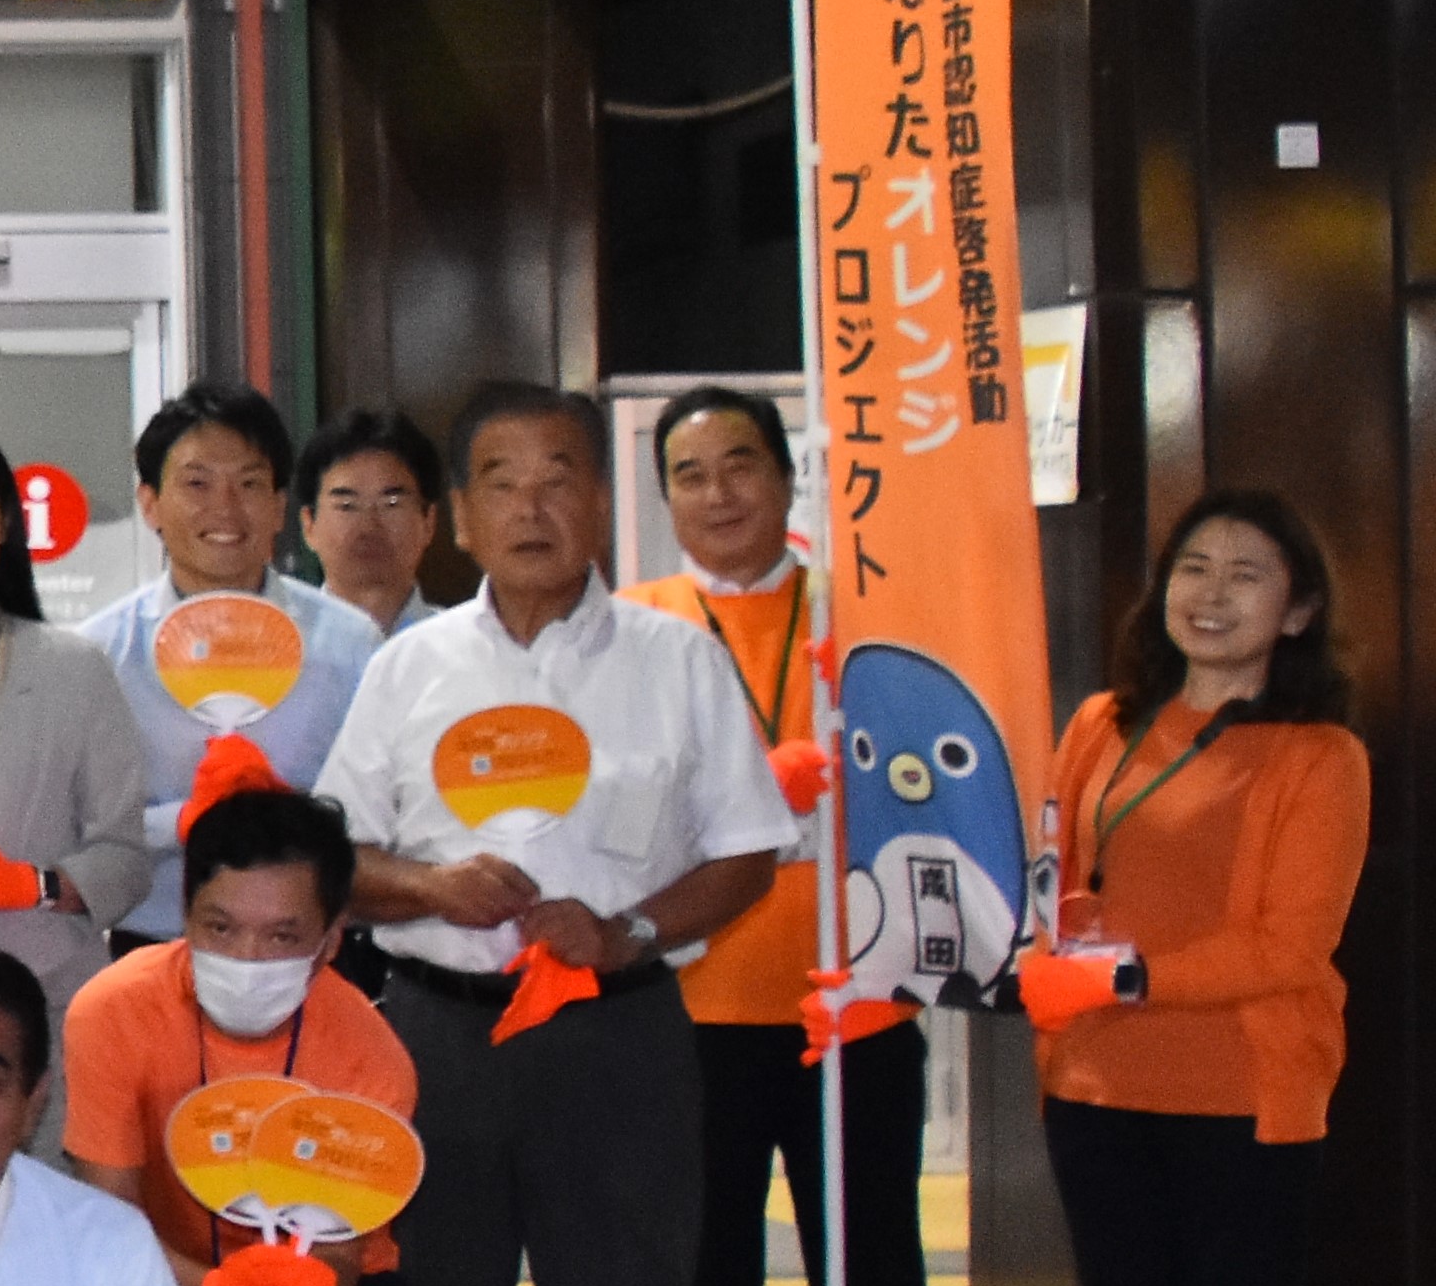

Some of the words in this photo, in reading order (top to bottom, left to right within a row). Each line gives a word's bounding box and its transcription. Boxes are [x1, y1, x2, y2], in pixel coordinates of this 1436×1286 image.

[831, 169, 888, 597] プロジェクト
